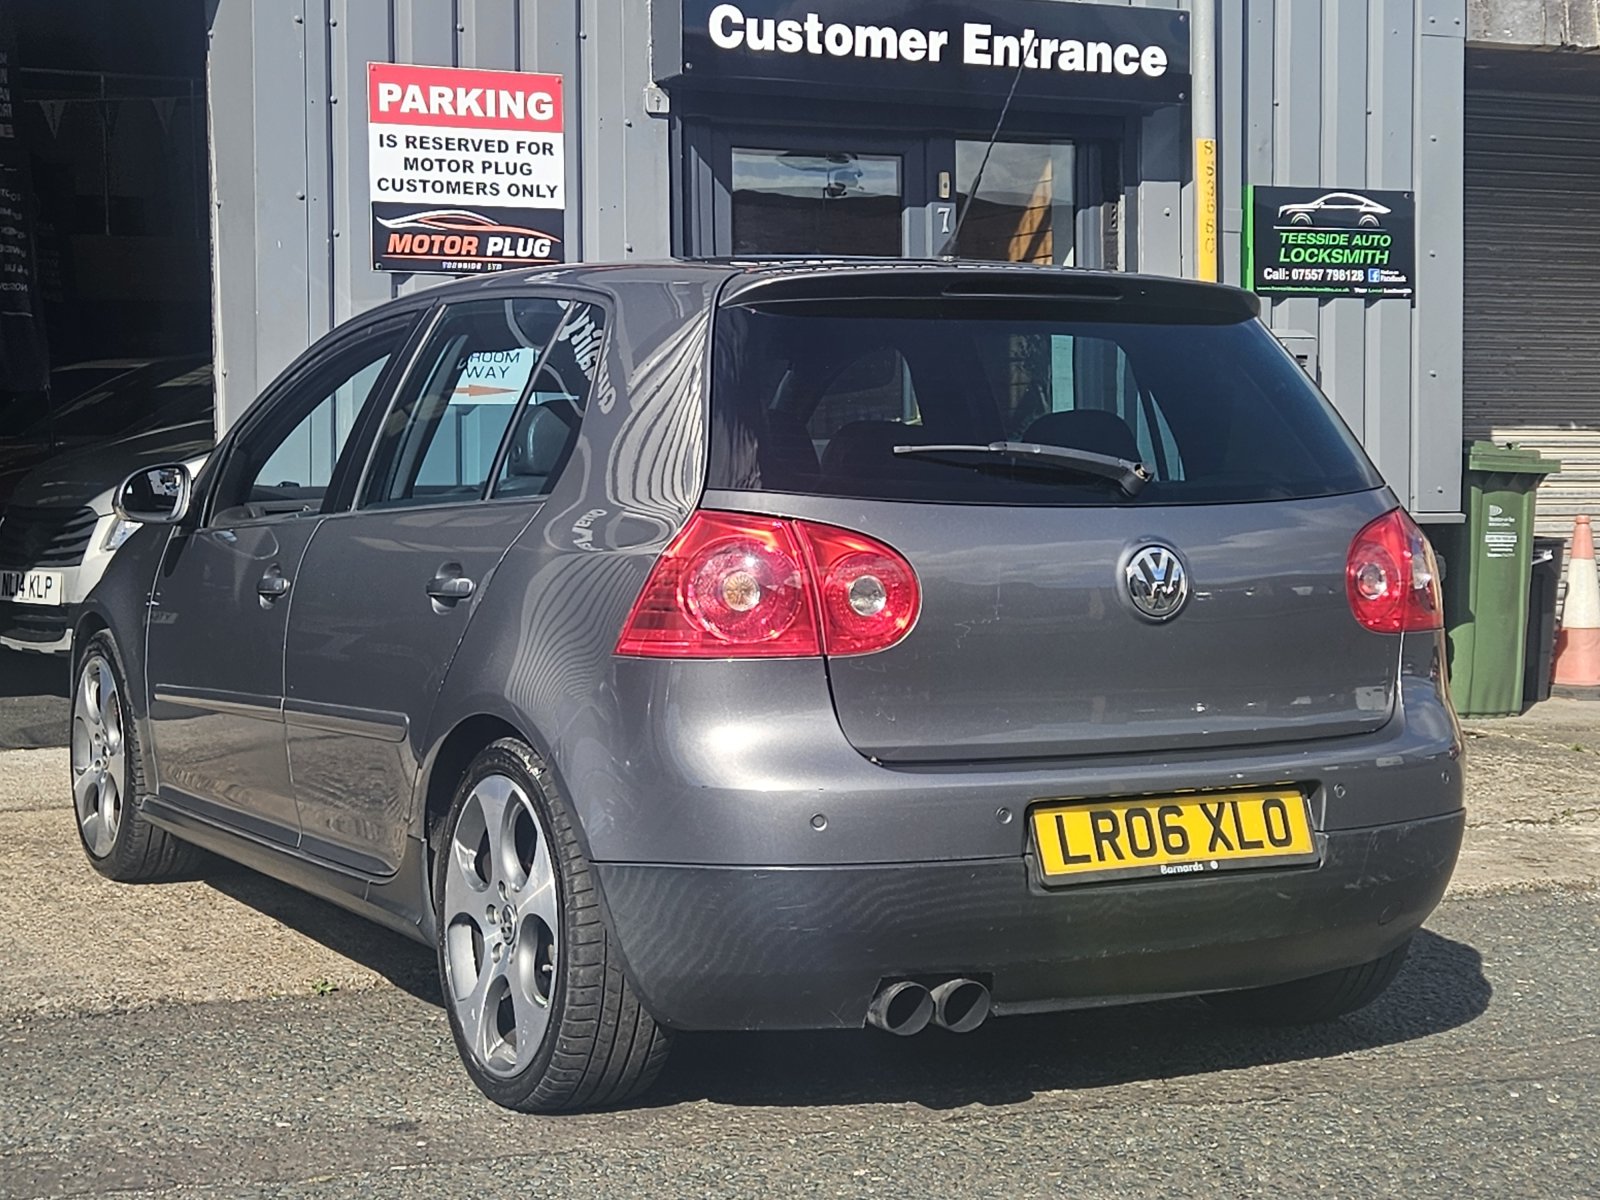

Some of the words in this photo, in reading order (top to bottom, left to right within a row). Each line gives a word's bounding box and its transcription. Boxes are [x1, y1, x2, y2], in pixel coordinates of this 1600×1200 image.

[708, 3, 948, 63] Customer
[963, 23, 1168, 77] Entrance
[378, 82, 554, 121] PARKING
[378, 134, 397, 148] IS
[405, 135, 509, 154] RESERVED
[516, 141, 554, 156] FOR
[403, 157, 474, 174] MOTOR
[481, 160, 533, 176] PLUG
[377, 178, 500, 196] CUSTOMERS
[507, 184, 558, 198] ONLY
[937, 207, 951, 233] 7
[387, 233, 480, 255] MOTOR
[486, 237, 551, 257] PLUG
[1279, 232, 1349, 246] TEESSIDE
[1352, 234, 1391, 247] AUTO
[1279, 248, 1389, 265] LOCKSMITH
[1263, 268, 1289, 280] Call:
[1291, 269, 1324, 281] 07557
[1326, 270, 1364, 282] 798128
[467, 366, 510, 379] WAY
[29, 575, 52, 599] KLP
[1055, 805, 1190, 865] LR06
[1200, 799, 1292, 852] XLO
[1160, 861, 1204, 874] Barnards
